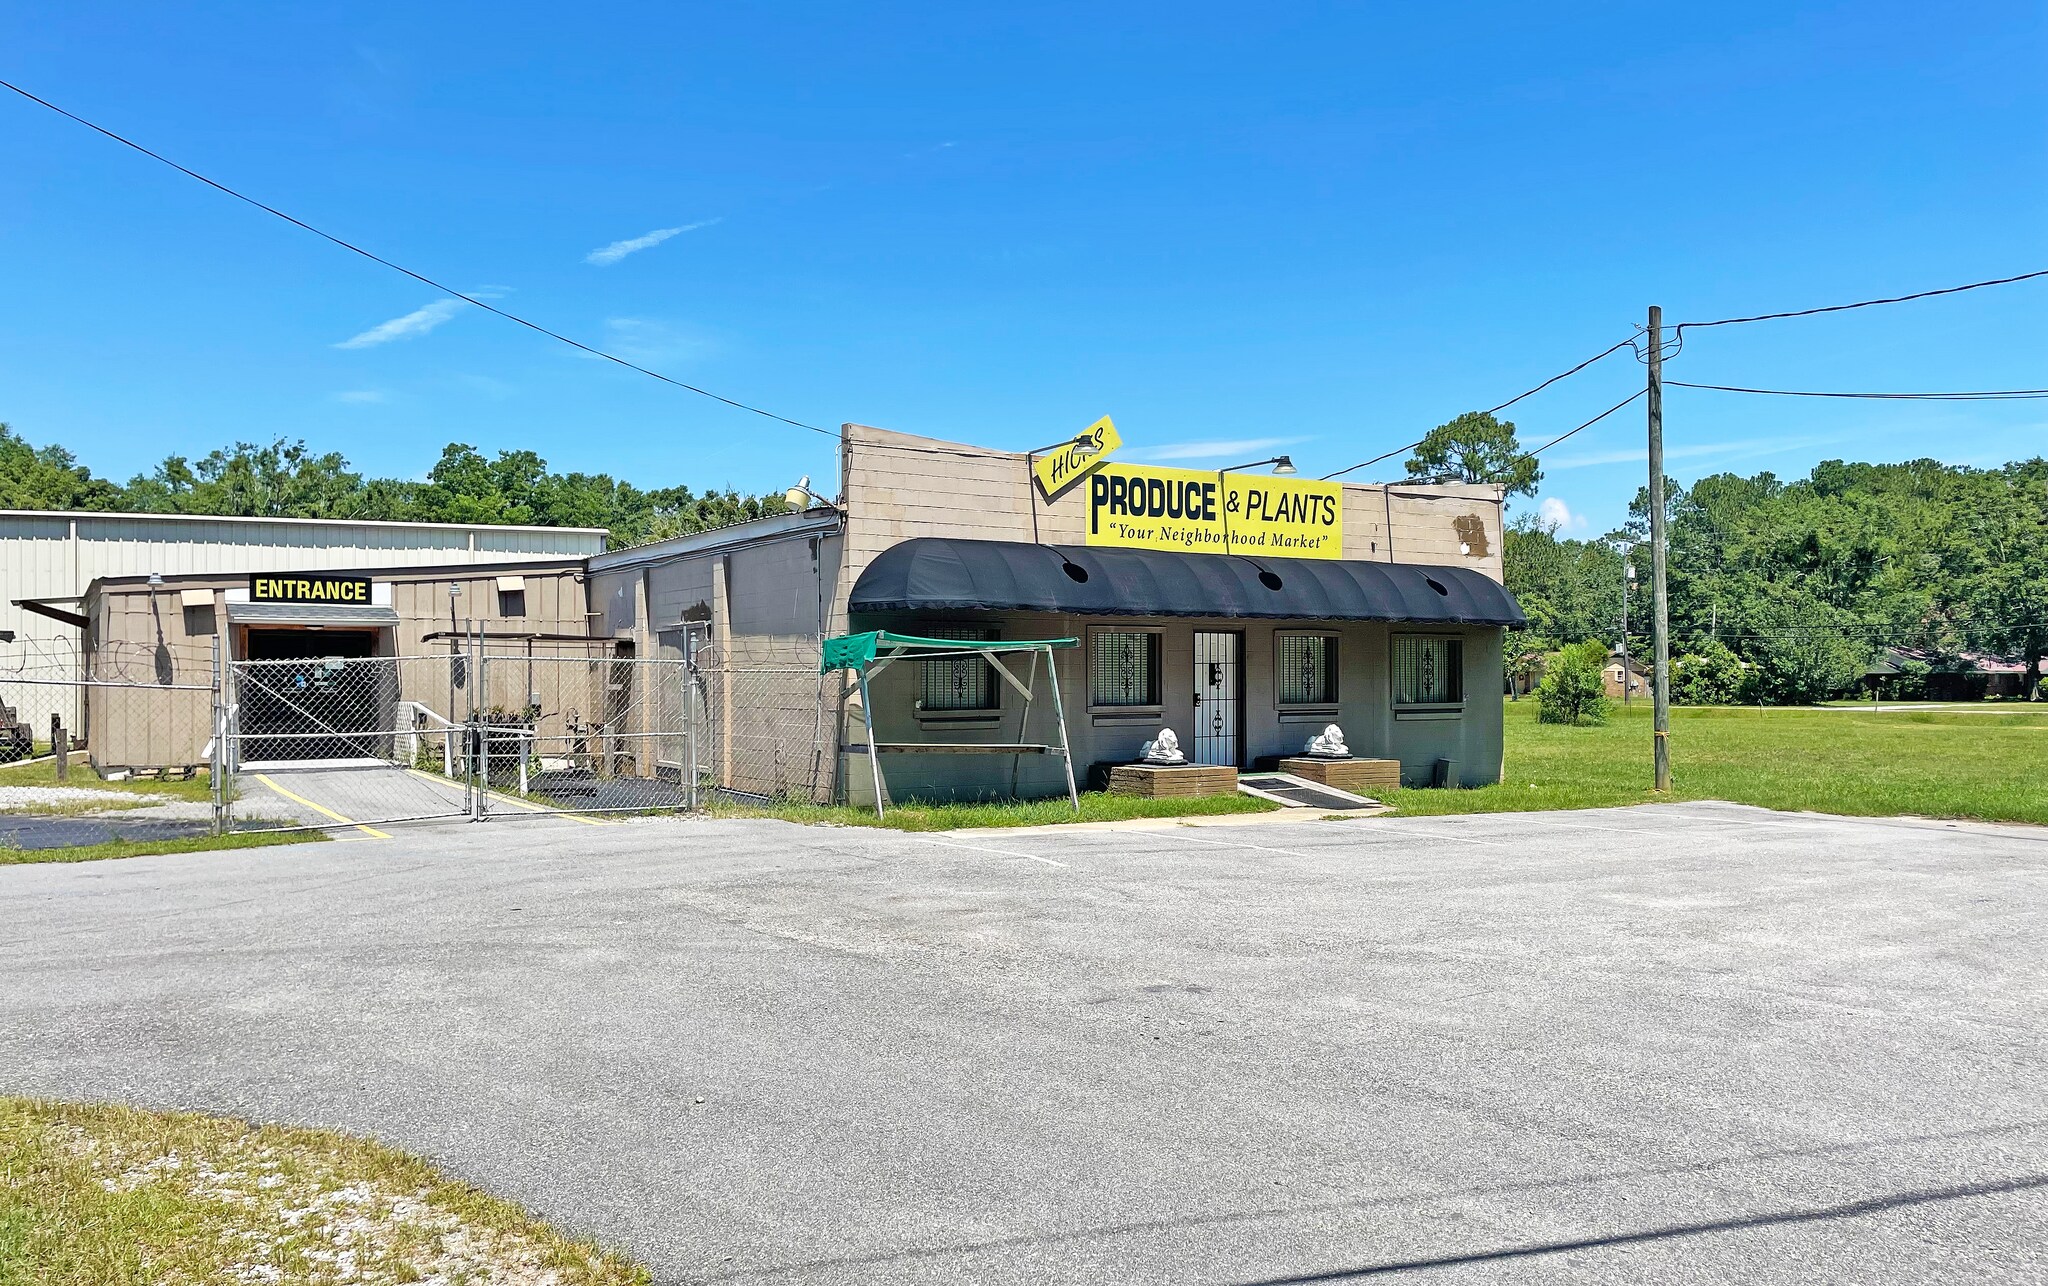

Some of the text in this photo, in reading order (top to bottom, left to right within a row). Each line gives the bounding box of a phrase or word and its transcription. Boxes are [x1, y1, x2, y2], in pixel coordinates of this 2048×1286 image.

[1051, 427, 1104, 483] HICS
[1091, 474, 1336, 534] PRODUCE & PLANTS
[1159, 526, 1266, 547] Neighborhood
[255, 579, 367, 601] ENTRANCE
